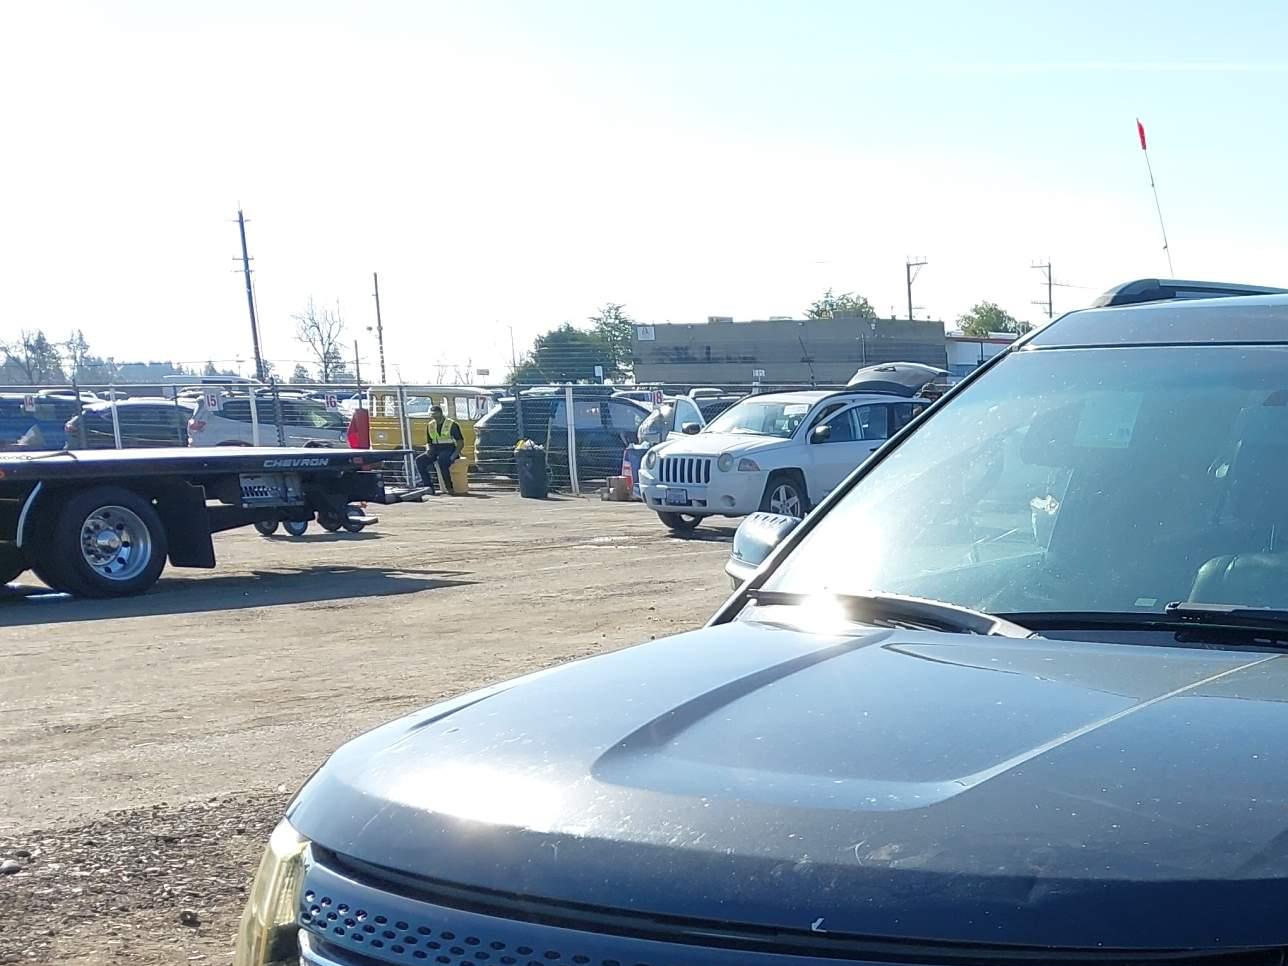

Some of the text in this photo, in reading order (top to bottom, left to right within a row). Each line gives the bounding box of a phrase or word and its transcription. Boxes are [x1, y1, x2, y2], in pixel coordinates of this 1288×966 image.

[206, 395, 217, 408] 15
[326, 395, 337, 408] 16
[476, 396, 487, 410] 17
[263, 458, 329, 468] CHEVRON
